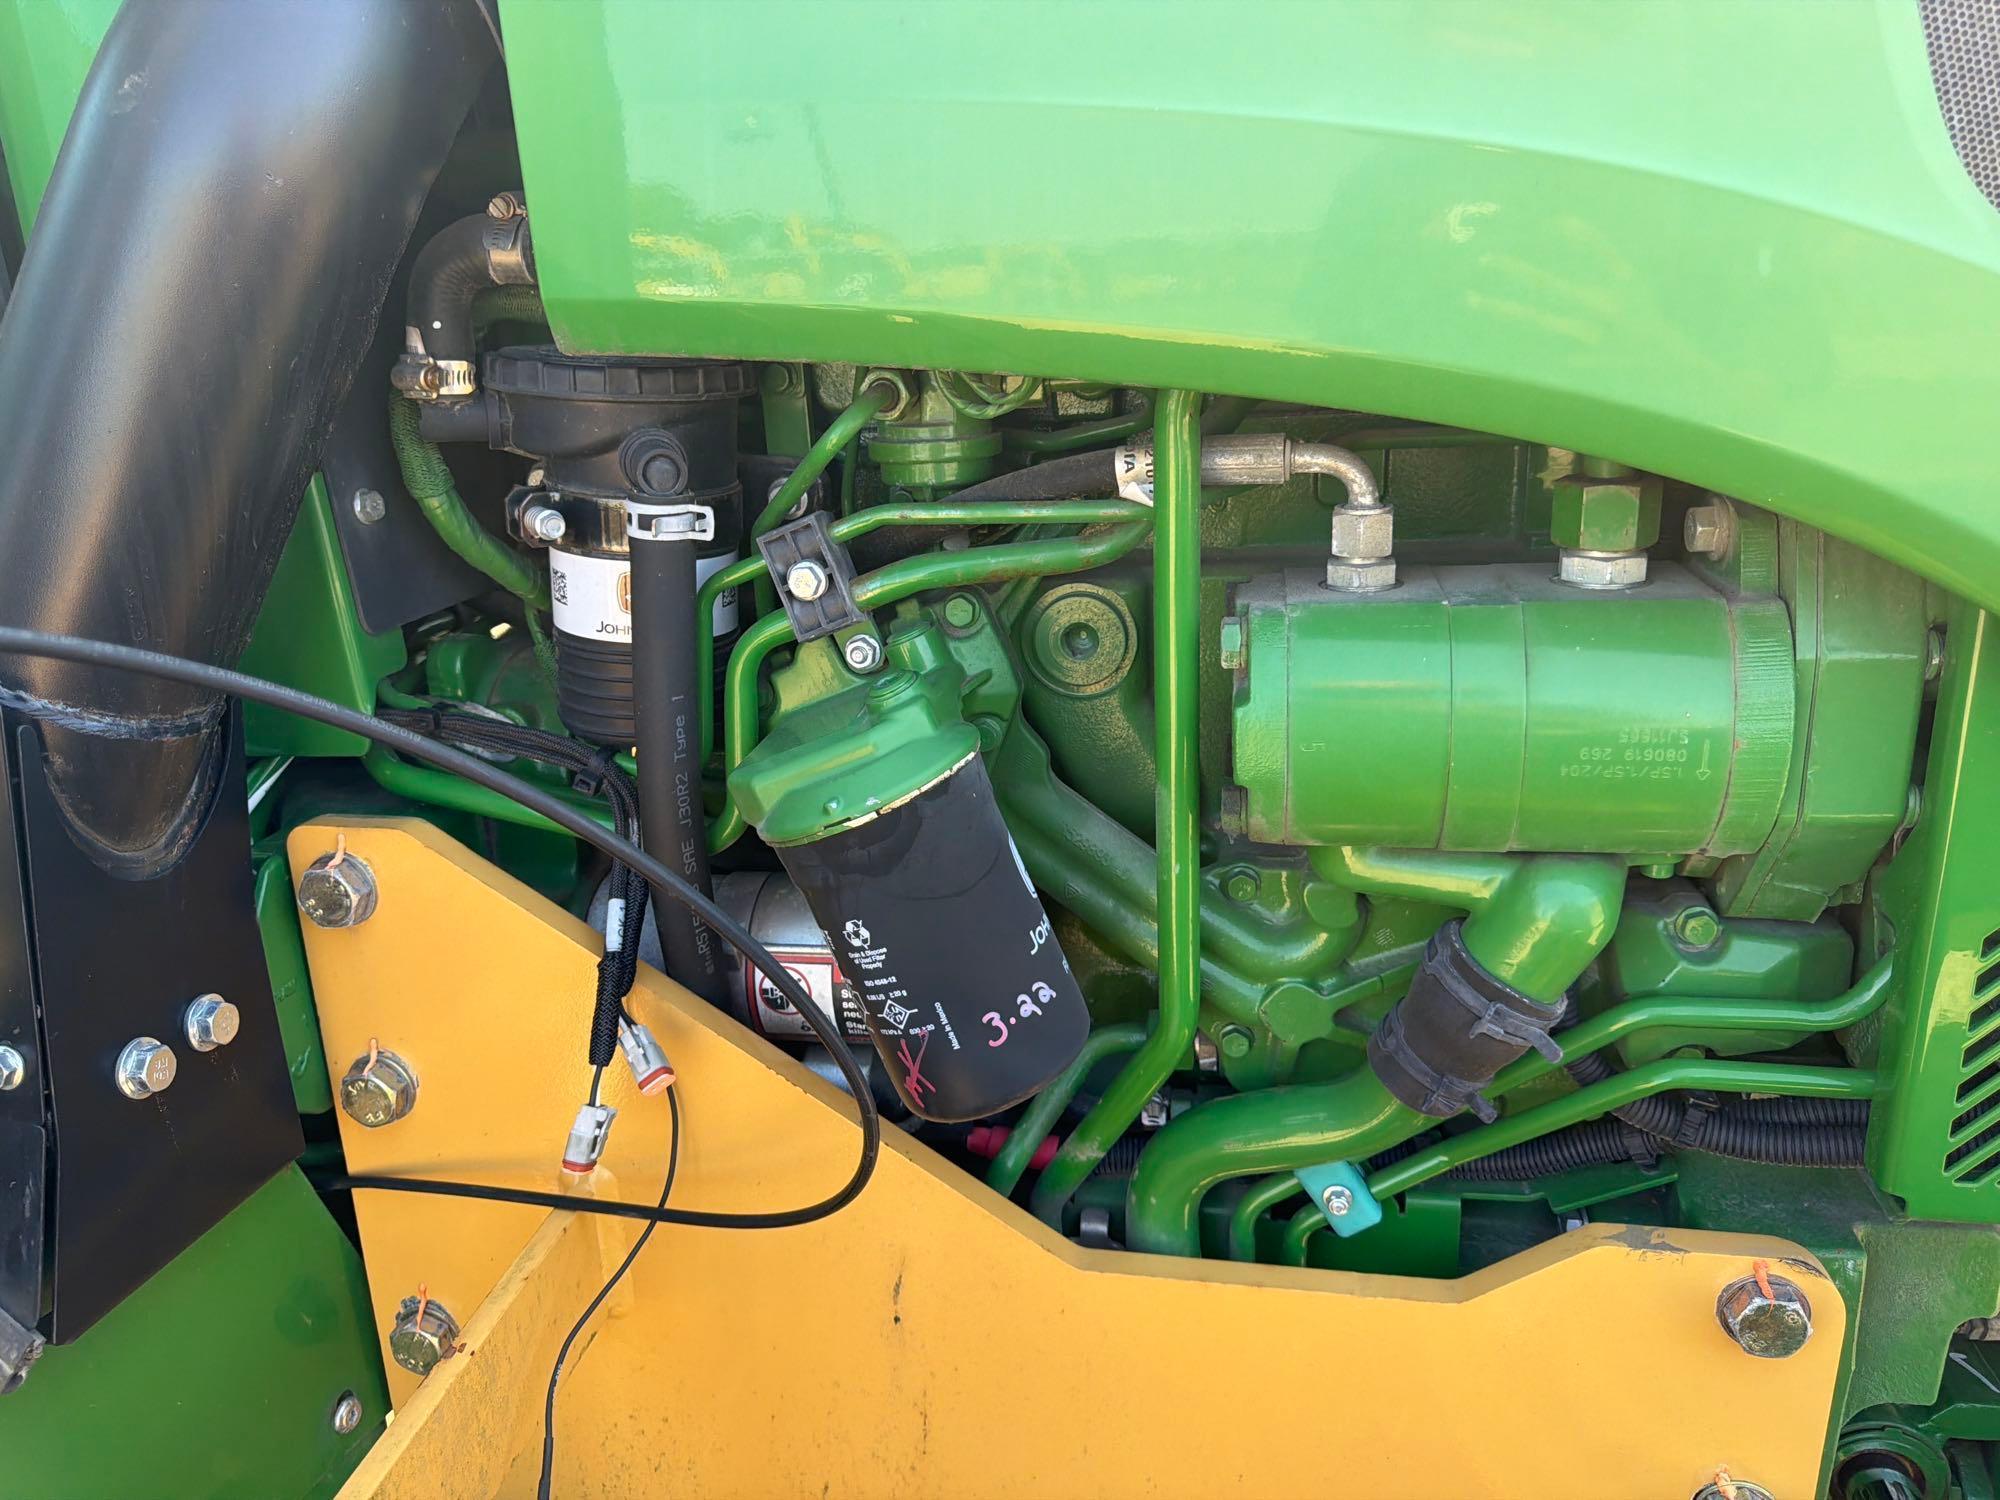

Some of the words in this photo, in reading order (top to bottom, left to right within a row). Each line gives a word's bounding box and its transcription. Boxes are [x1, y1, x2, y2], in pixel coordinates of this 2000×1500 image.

[672, 694, 684, 702] 1
[673, 714, 687, 763] Type
[675, 771, 693, 828] J30R2
[681, 837, 697, 875] SAE
[981, 981, 1057, 1047] 3.22
